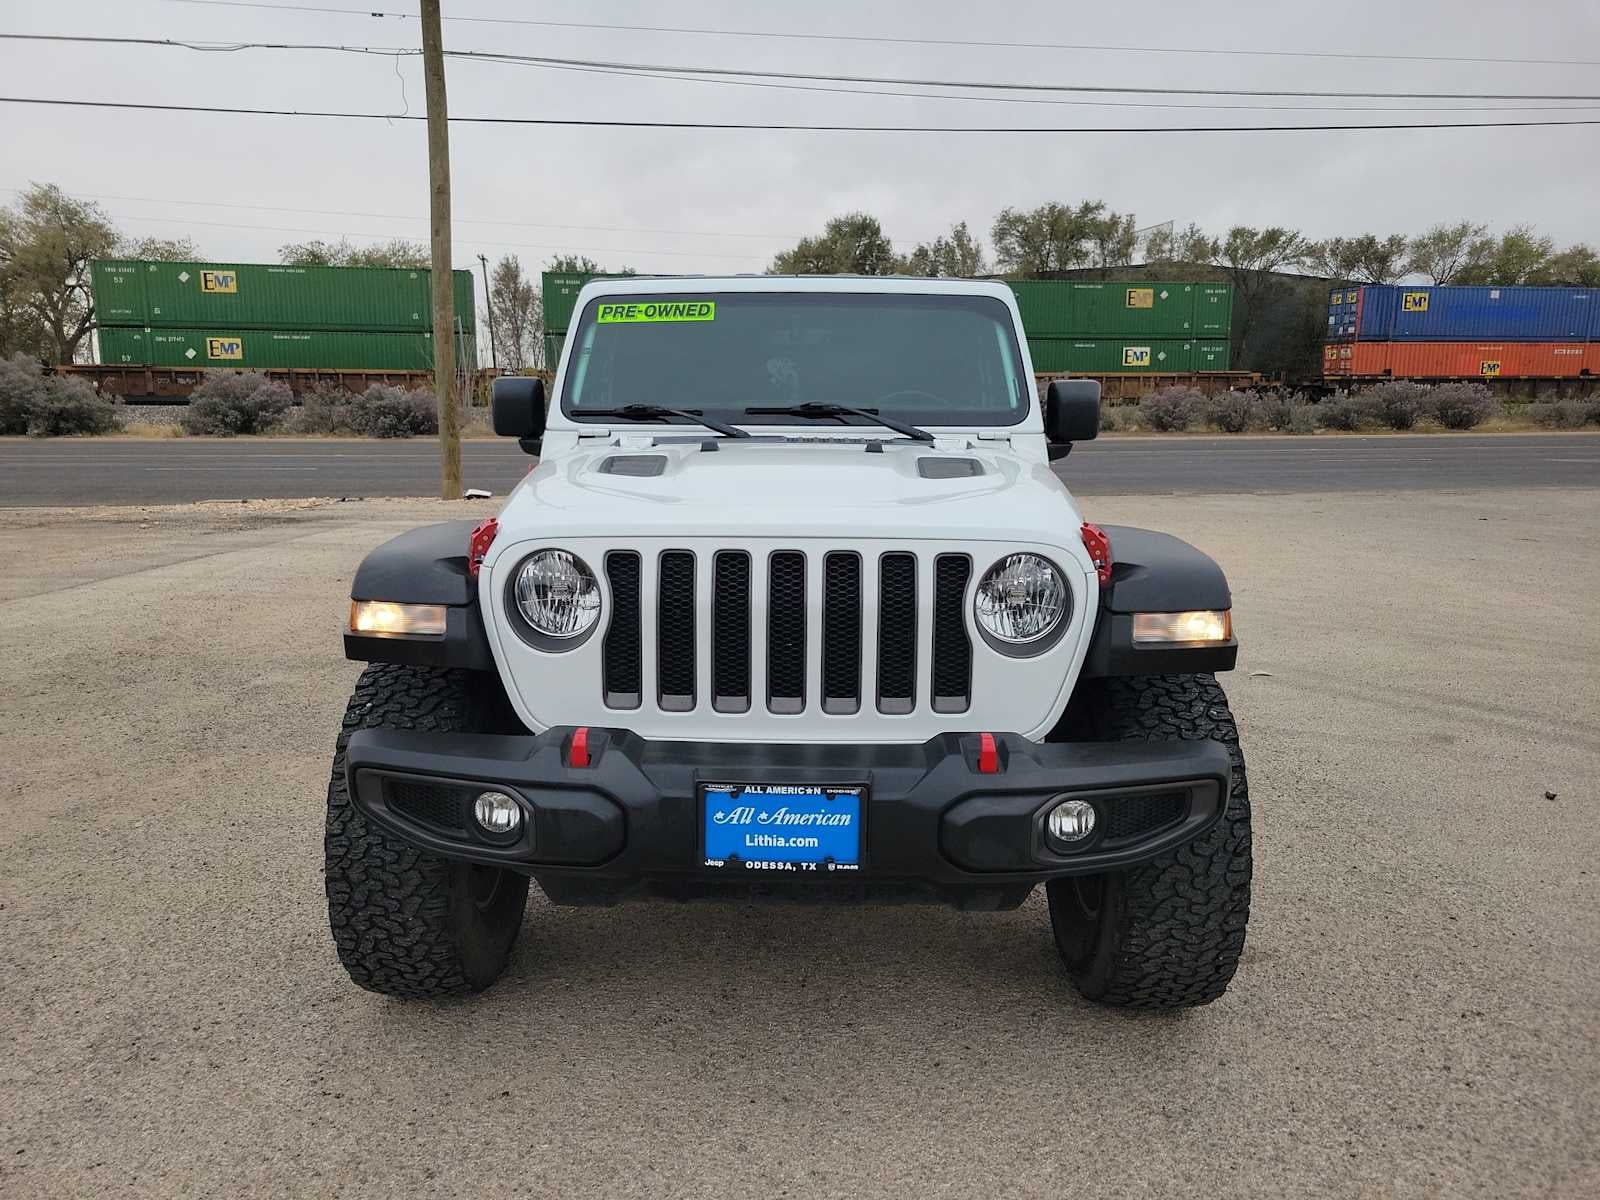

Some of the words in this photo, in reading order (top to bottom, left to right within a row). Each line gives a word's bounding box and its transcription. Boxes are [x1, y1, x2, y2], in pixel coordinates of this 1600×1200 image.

[203, 272, 234, 290] EMP
[1404, 294, 1427, 310] EMP
[601, 303, 711, 319] PRE-OWNED
[209, 339, 240, 357] EMP
[1124, 348, 1148, 364] EMP
[744, 786, 764, 794] ALL
[713, 806, 755, 825] All
[757, 807, 852, 826] American
[745, 834, 819, 847] Lithia.com
[704, 859, 724, 868] Jeep
[745, 861, 797, 872] ODESSA,
[801, 862, 817, 871] TX
